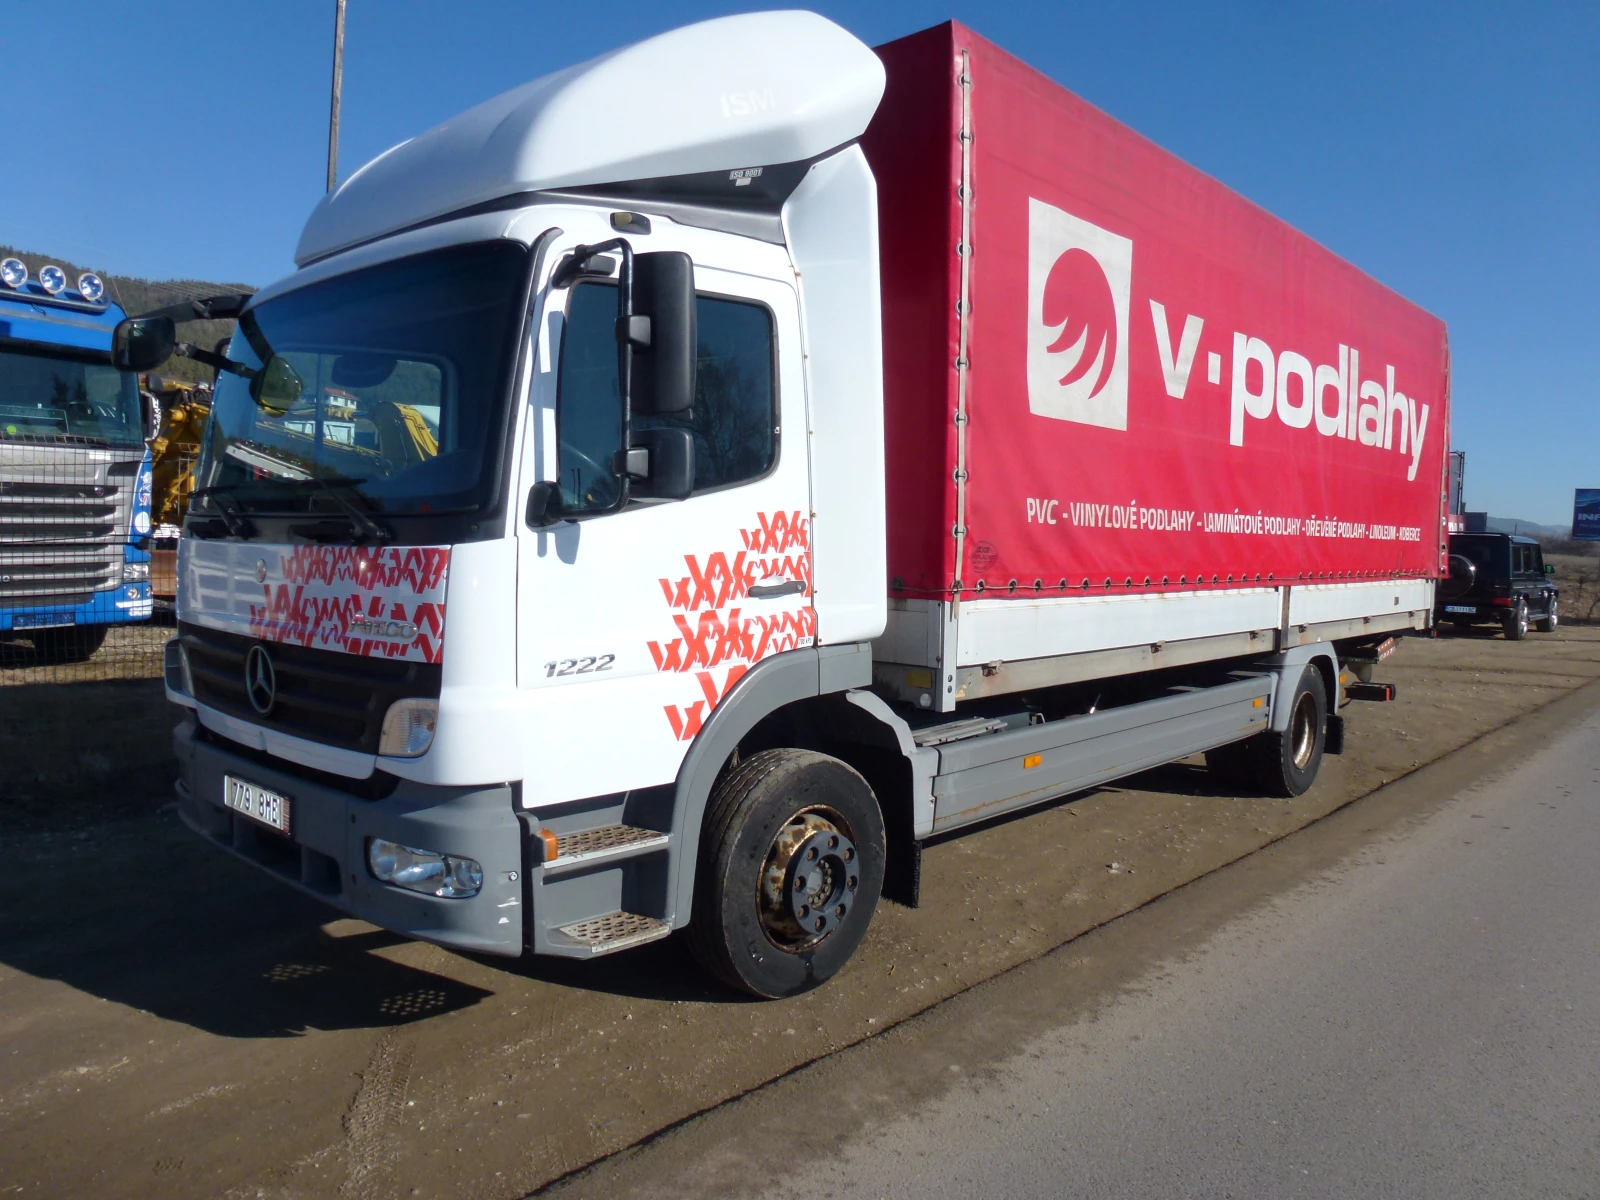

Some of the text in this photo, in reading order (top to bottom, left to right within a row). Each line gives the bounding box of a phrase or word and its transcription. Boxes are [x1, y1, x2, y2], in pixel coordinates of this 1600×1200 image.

[721, 88, 776, 117] ISM
[1026, 497, 1059, 525] PVC
[1069, 499, 1138, 529] VINYLOVÉ
[1139, 507, 1195, 532] PODLAHY
[1203, 507, 1264, 535] LAMINÁTOVÉ
[1263, 516, 1302, 536] PODLAHY
[1337, 521, 1366, 539] PODLAHY
[1369, 523, 1397, 541] LINOLEUM
[1399, 526, 1421, 542] KOBERCE
[544, 654, 616, 678] 1222
[232, 782, 253, 811] 779
